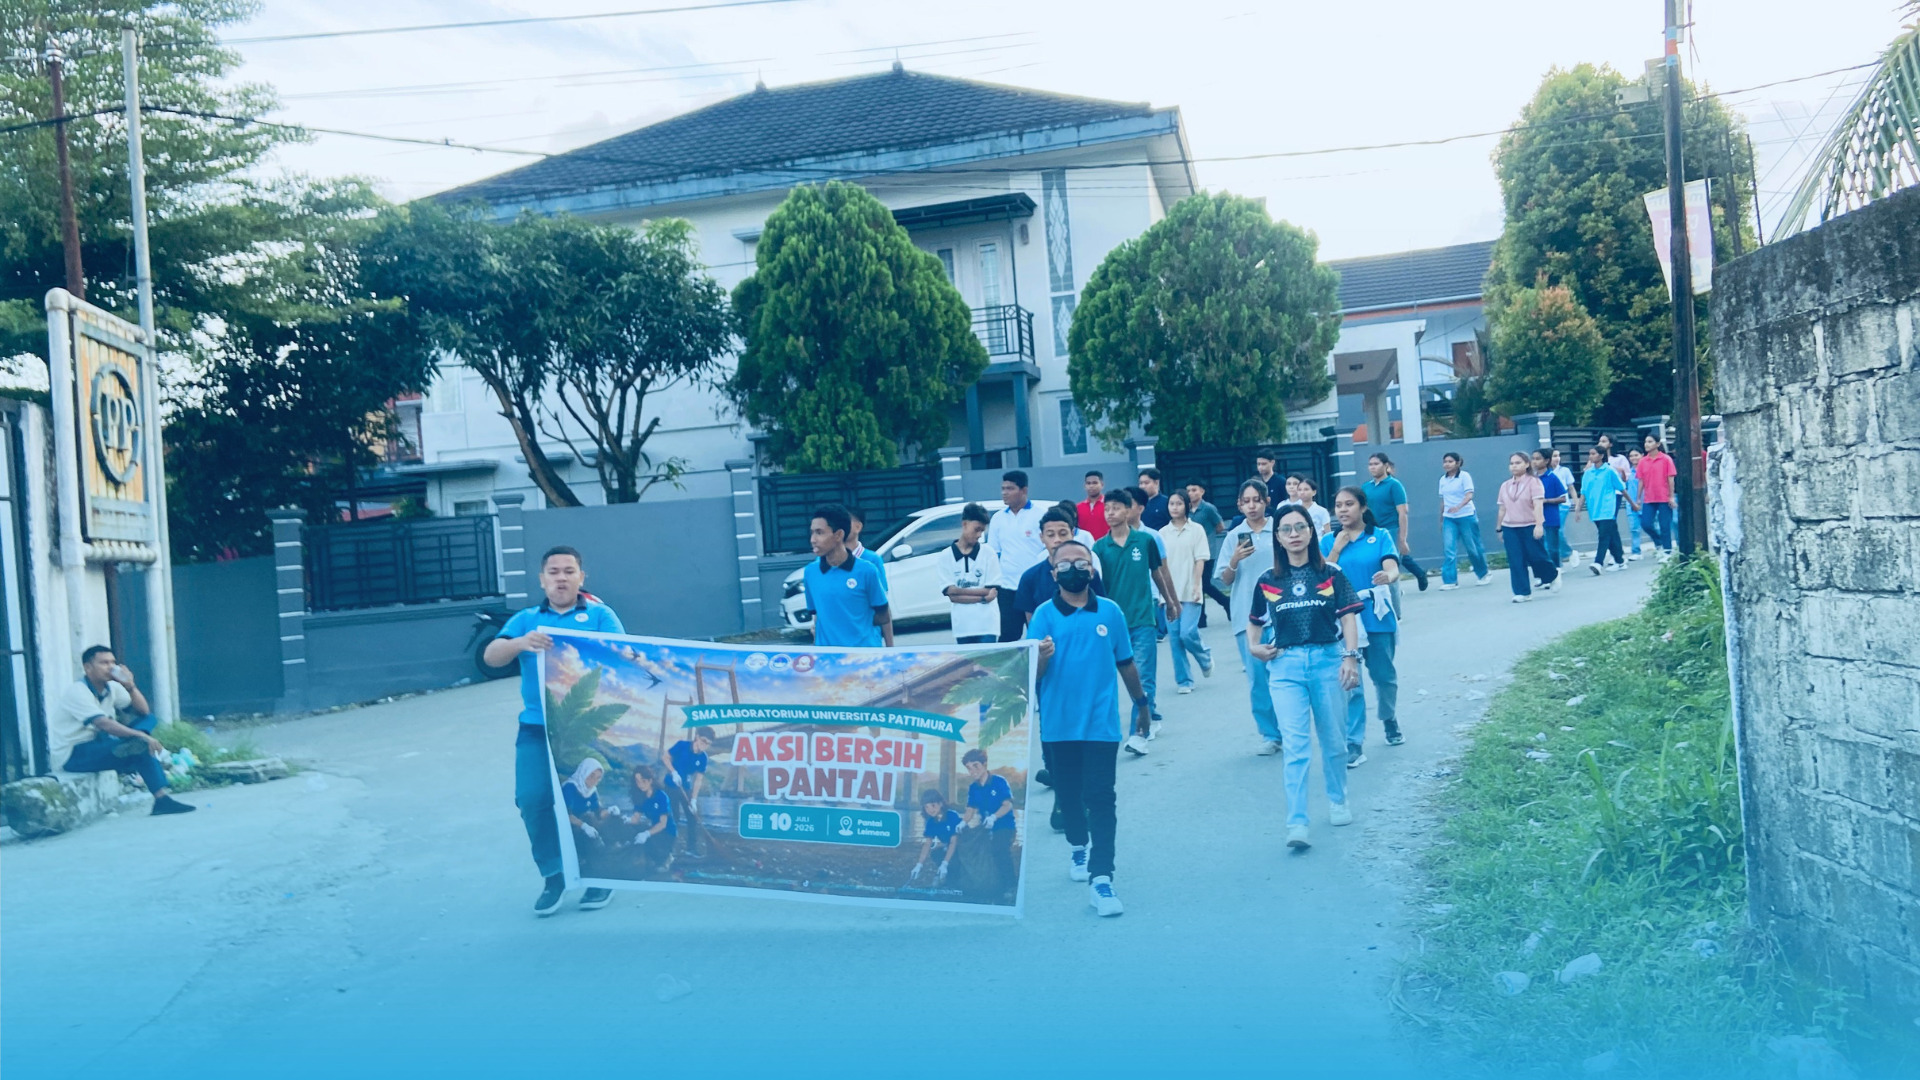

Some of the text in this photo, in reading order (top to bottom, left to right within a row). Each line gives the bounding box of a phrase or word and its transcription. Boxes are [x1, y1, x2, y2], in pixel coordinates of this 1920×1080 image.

[1275, 599, 1326, 612] GERMANY
[691, 708, 954, 733] SMA LABORATORIUM UNIVERSITAS PATTIMURA
[734, 735, 924, 769] AKSI BERSIH
[767, 766, 894, 802] PANTAI
[769, 812, 792, 831] 10
[794, 824, 815, 832] 2026
[857, 819, 882, 828] Pantai
[857, 828, 890, 837] Leimena
